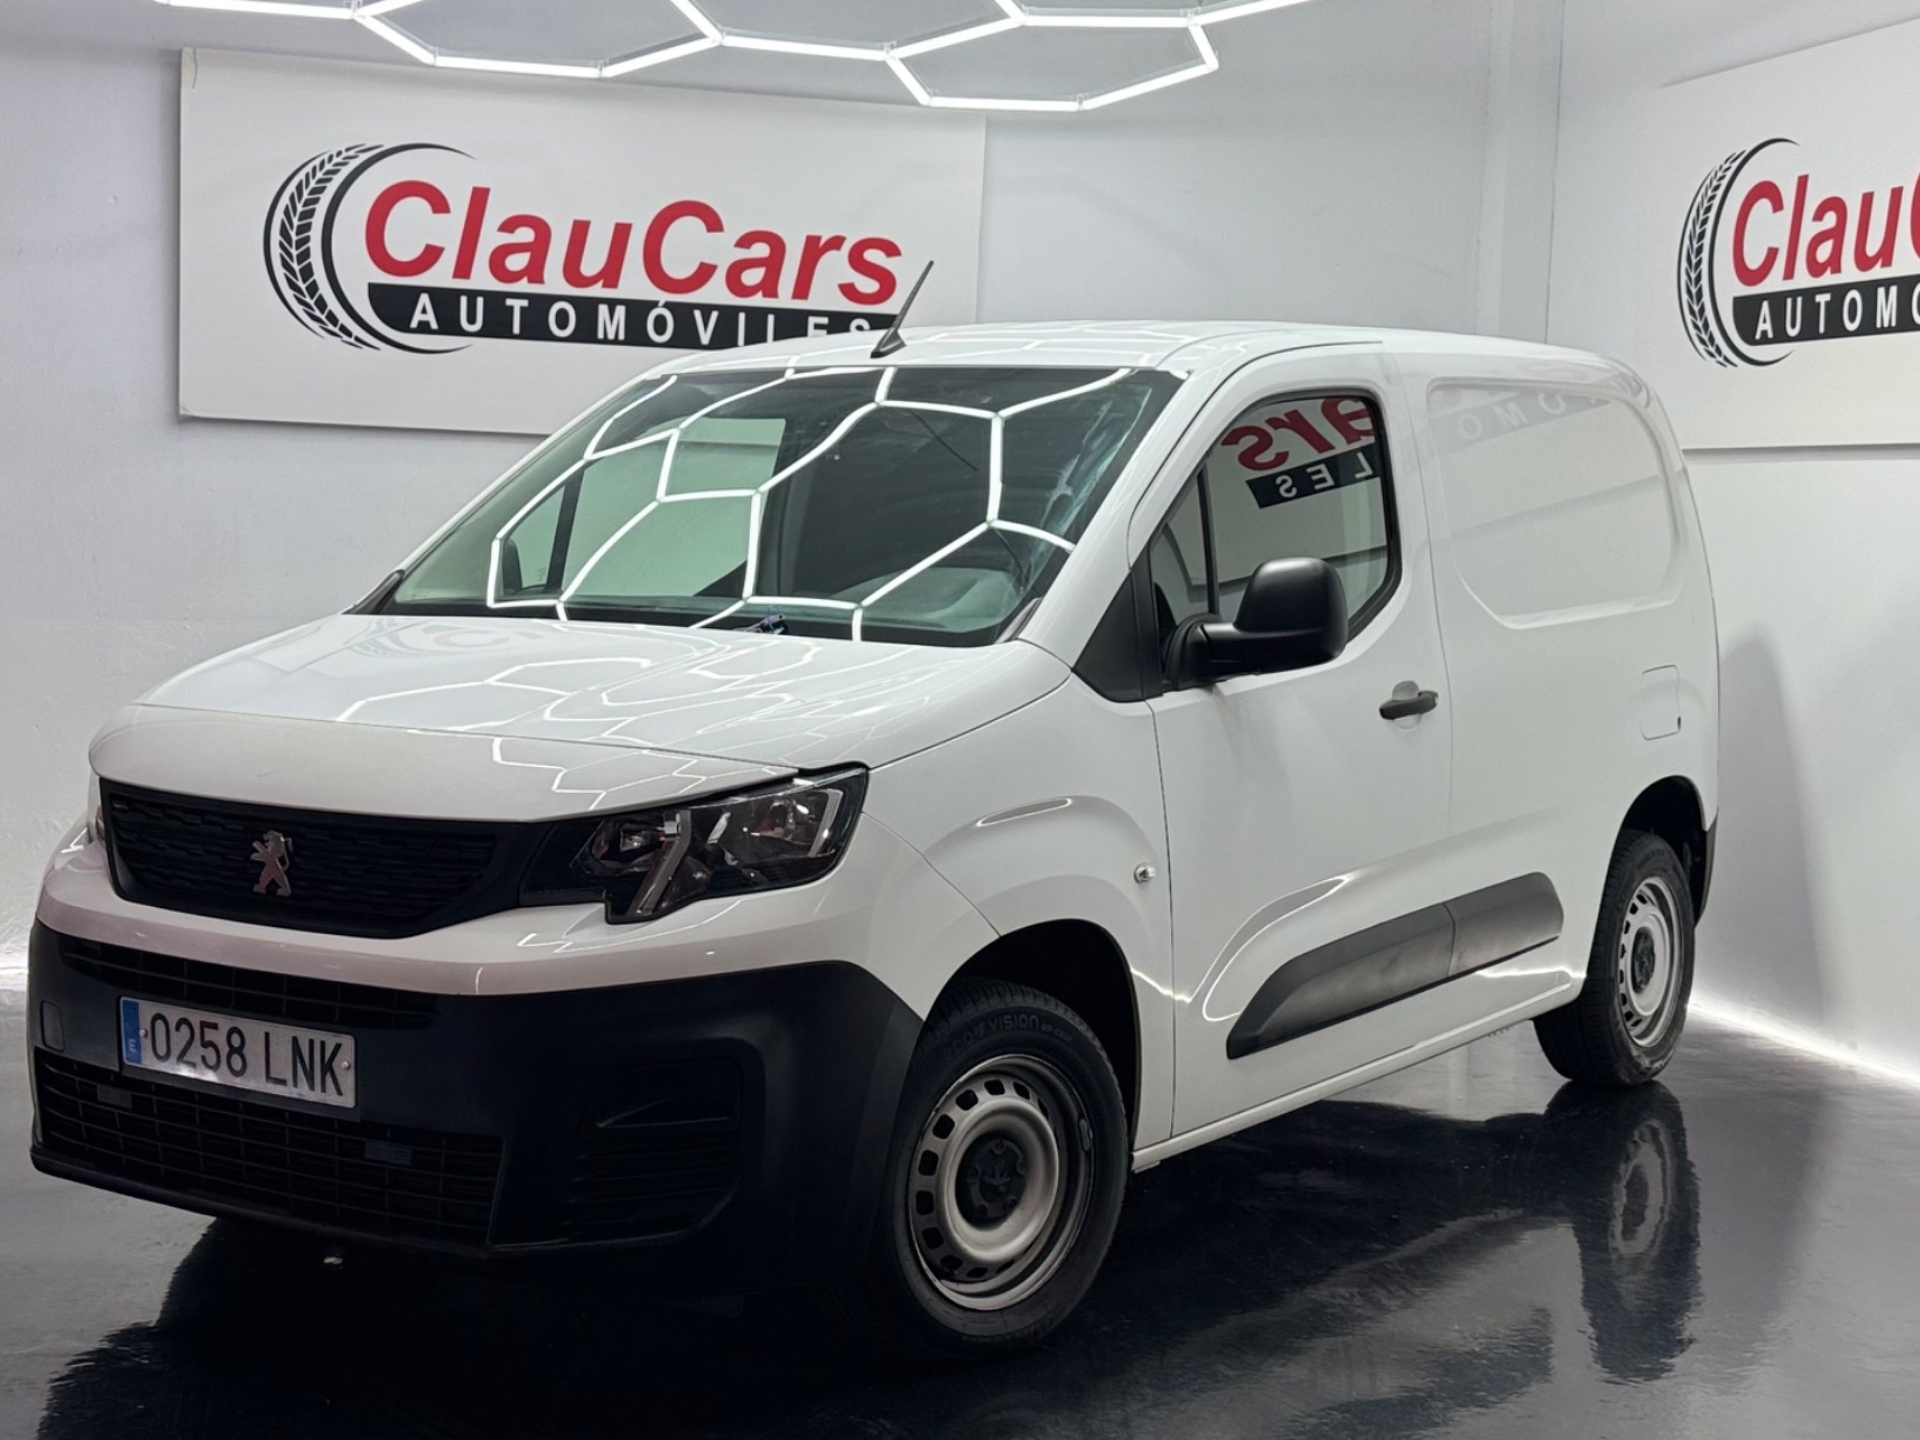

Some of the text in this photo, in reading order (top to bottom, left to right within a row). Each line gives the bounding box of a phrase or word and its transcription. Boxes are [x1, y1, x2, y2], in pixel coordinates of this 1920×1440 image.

[364, 180, 903, 306] ClauCars
[1732, 171, 1920, 287] Clau
[151, 1013, 247, 1078] 0258
[264, 1031, 344, 1096] LNK
